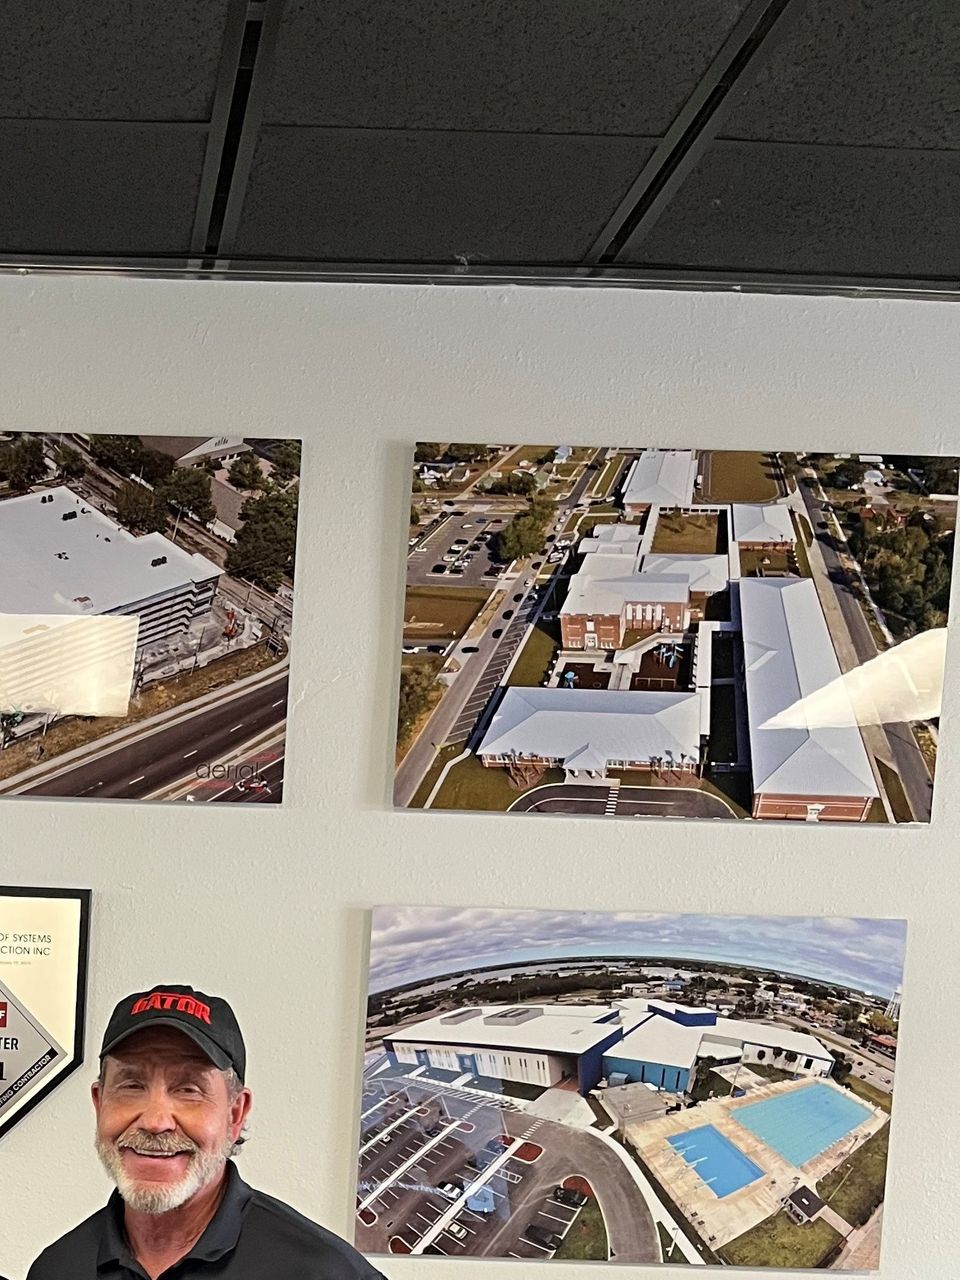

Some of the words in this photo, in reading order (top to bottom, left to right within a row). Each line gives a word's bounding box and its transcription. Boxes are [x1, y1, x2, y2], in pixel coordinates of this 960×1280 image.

[195, 761, 260, 780] aerial
[13, 933, 52, 943] SYSTEMS
[33, 947, 51, 956] INC
[131, 992, 211, 1025] GATOR
[12, 1054, 52, 1091] CONTRACTOR
